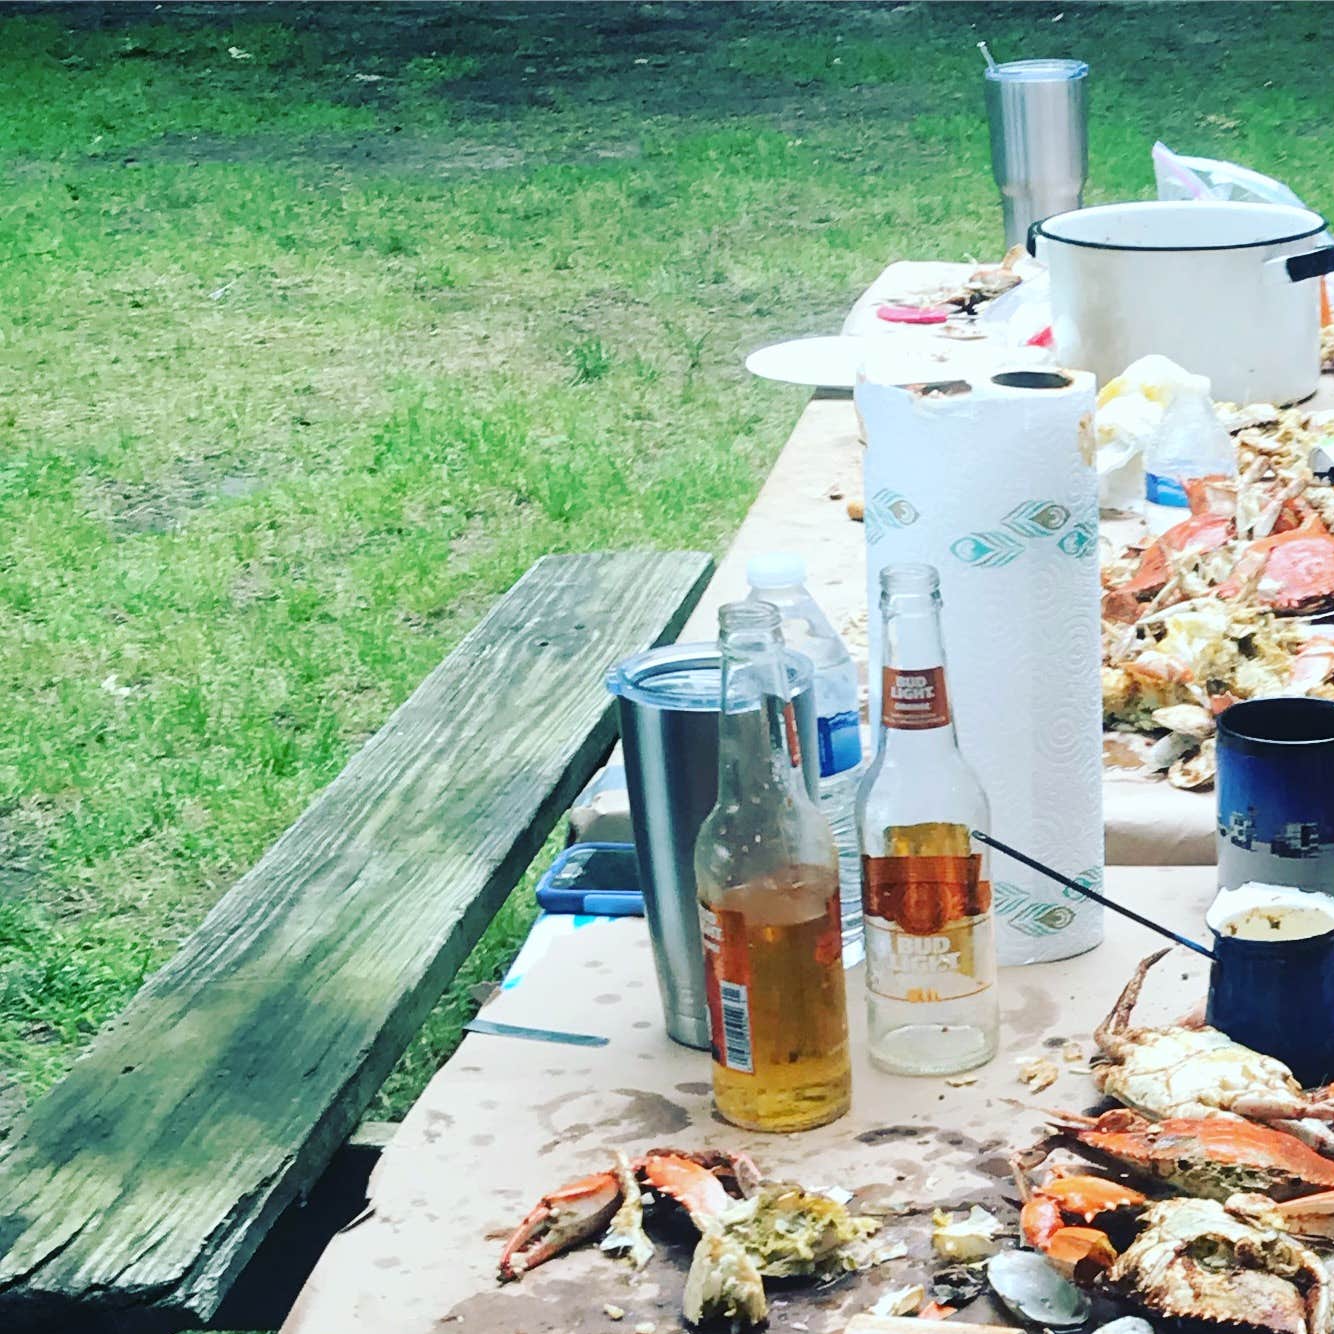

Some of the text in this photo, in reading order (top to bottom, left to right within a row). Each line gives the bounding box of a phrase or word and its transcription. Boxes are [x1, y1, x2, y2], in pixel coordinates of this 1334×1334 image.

[896, 677, 927, 687] BUD
[891, 687, 936, 700] LIGHT
[897, 936, 951, 955] BUD
[889, 952, 961, 973] LIGHT
